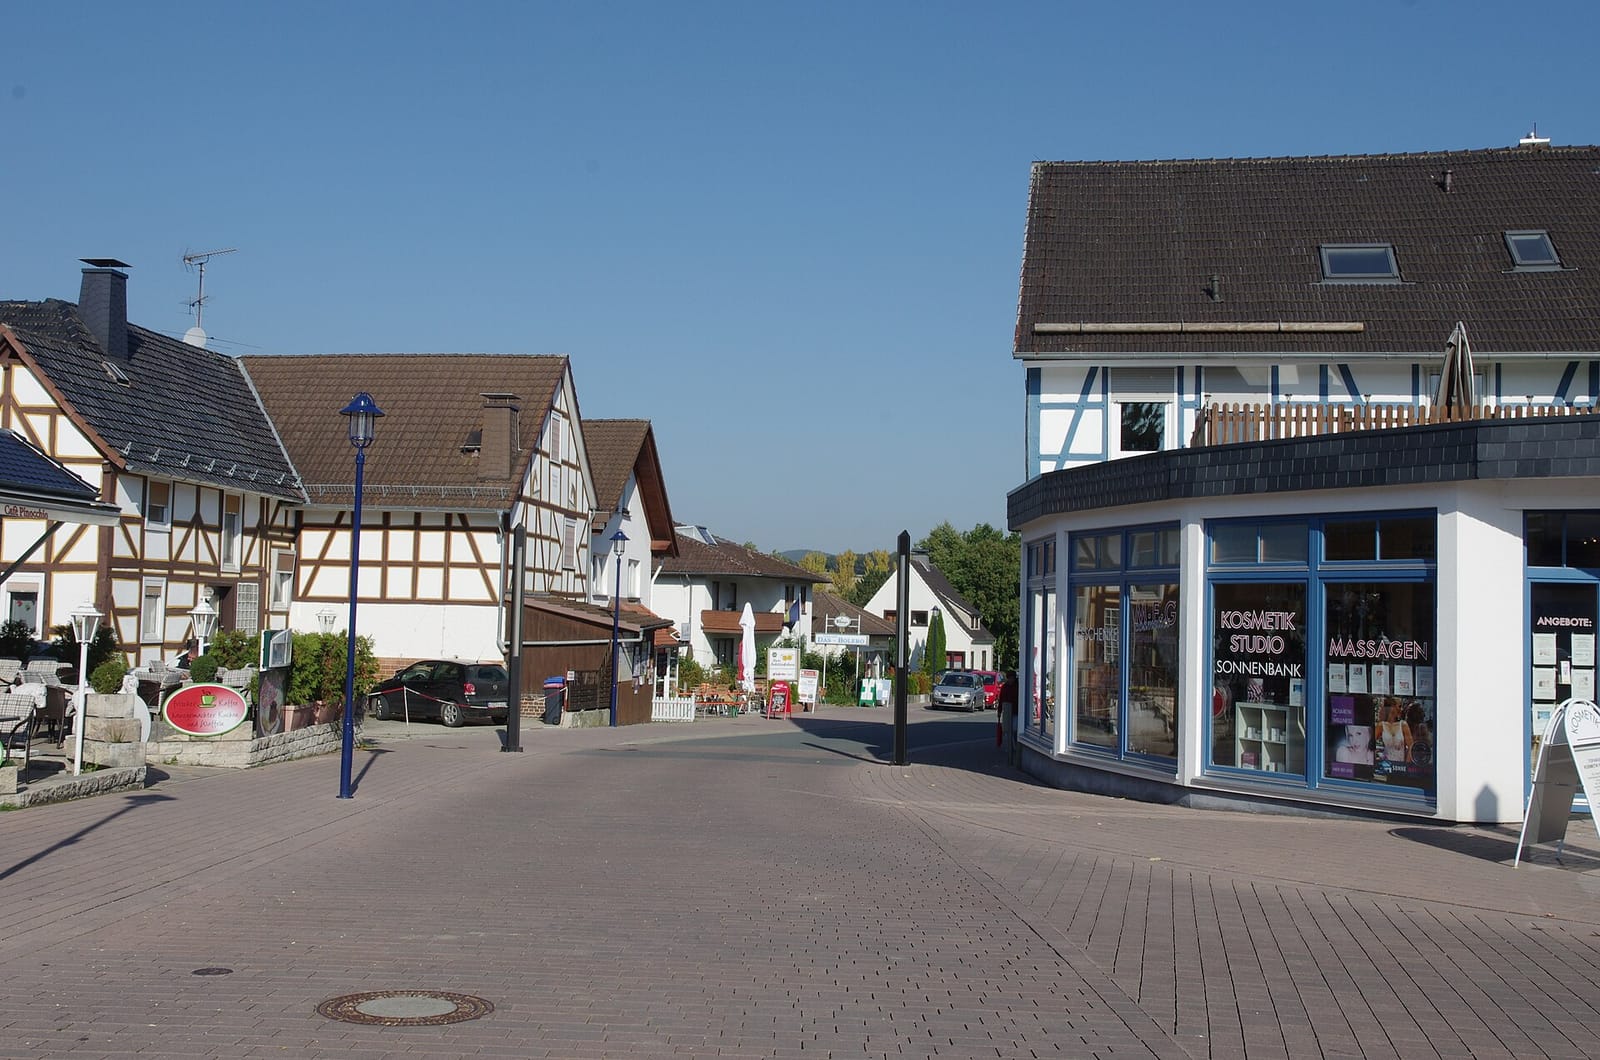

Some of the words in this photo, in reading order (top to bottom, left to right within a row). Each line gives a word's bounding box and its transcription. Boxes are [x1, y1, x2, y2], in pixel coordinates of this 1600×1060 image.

[1220, 609, 1296, 630] KOSMETIK
[1536, 616, 1593, 627] ANGEBOTE:
[1229, 634, 1284, 654] STUDIO
[1328, 637, 1428, 660] MASSAGEN
[1216, 659, 1301, 677] SONNENBANK
